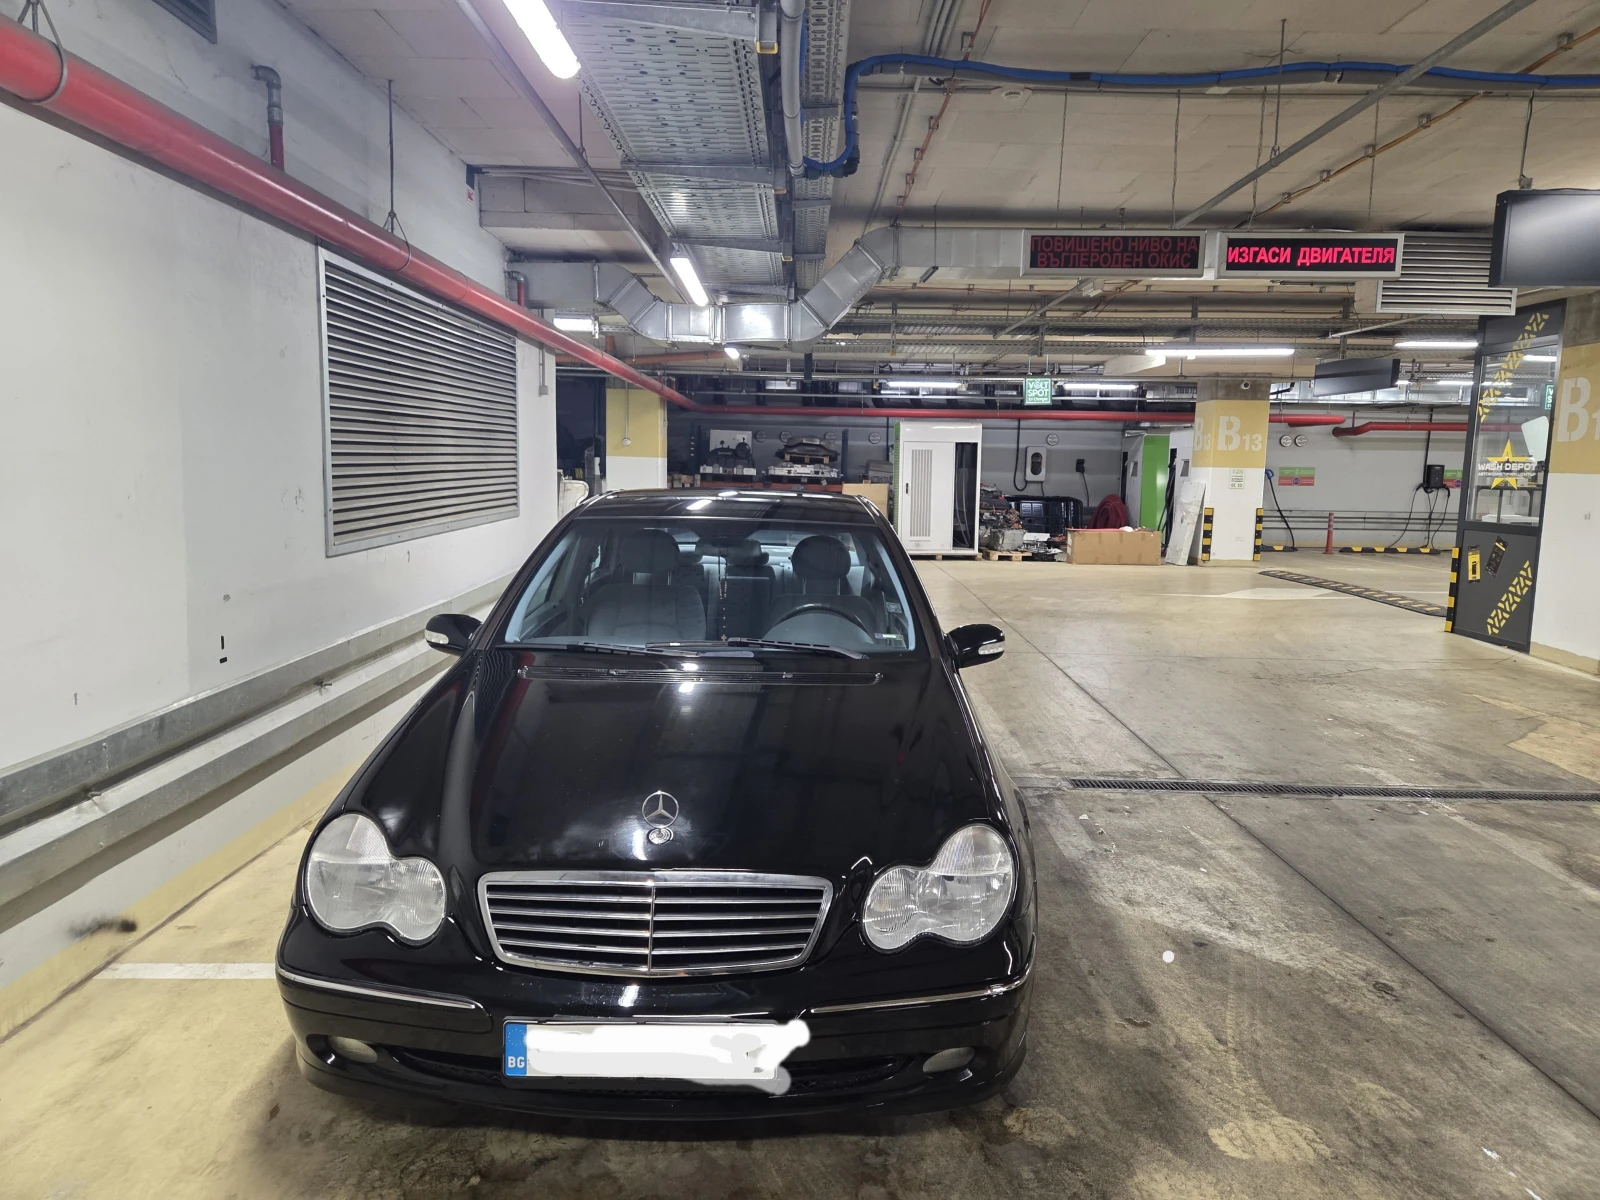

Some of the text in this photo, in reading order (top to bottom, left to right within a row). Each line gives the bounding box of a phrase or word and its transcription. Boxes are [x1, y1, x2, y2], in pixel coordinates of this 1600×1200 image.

[1031, 237, 1199, 252] ПОВИШЕНО НИВО НА
[1037, 252, 1191, 268] ВЪГЛЕРОДЕН ОКИС
[1228, 247, 1395, 266] ИЗГАСИ ДВИГАТЕЛЯ
[1028, 381, 1049, 389] VOLT
[1027, 389, 1049, 397] SPOT
[1217, 415, 1263, 452] B13
[1478, 462, 1537, 471] WASH DEPOT
[508, 1056, 525, 1068] BG
